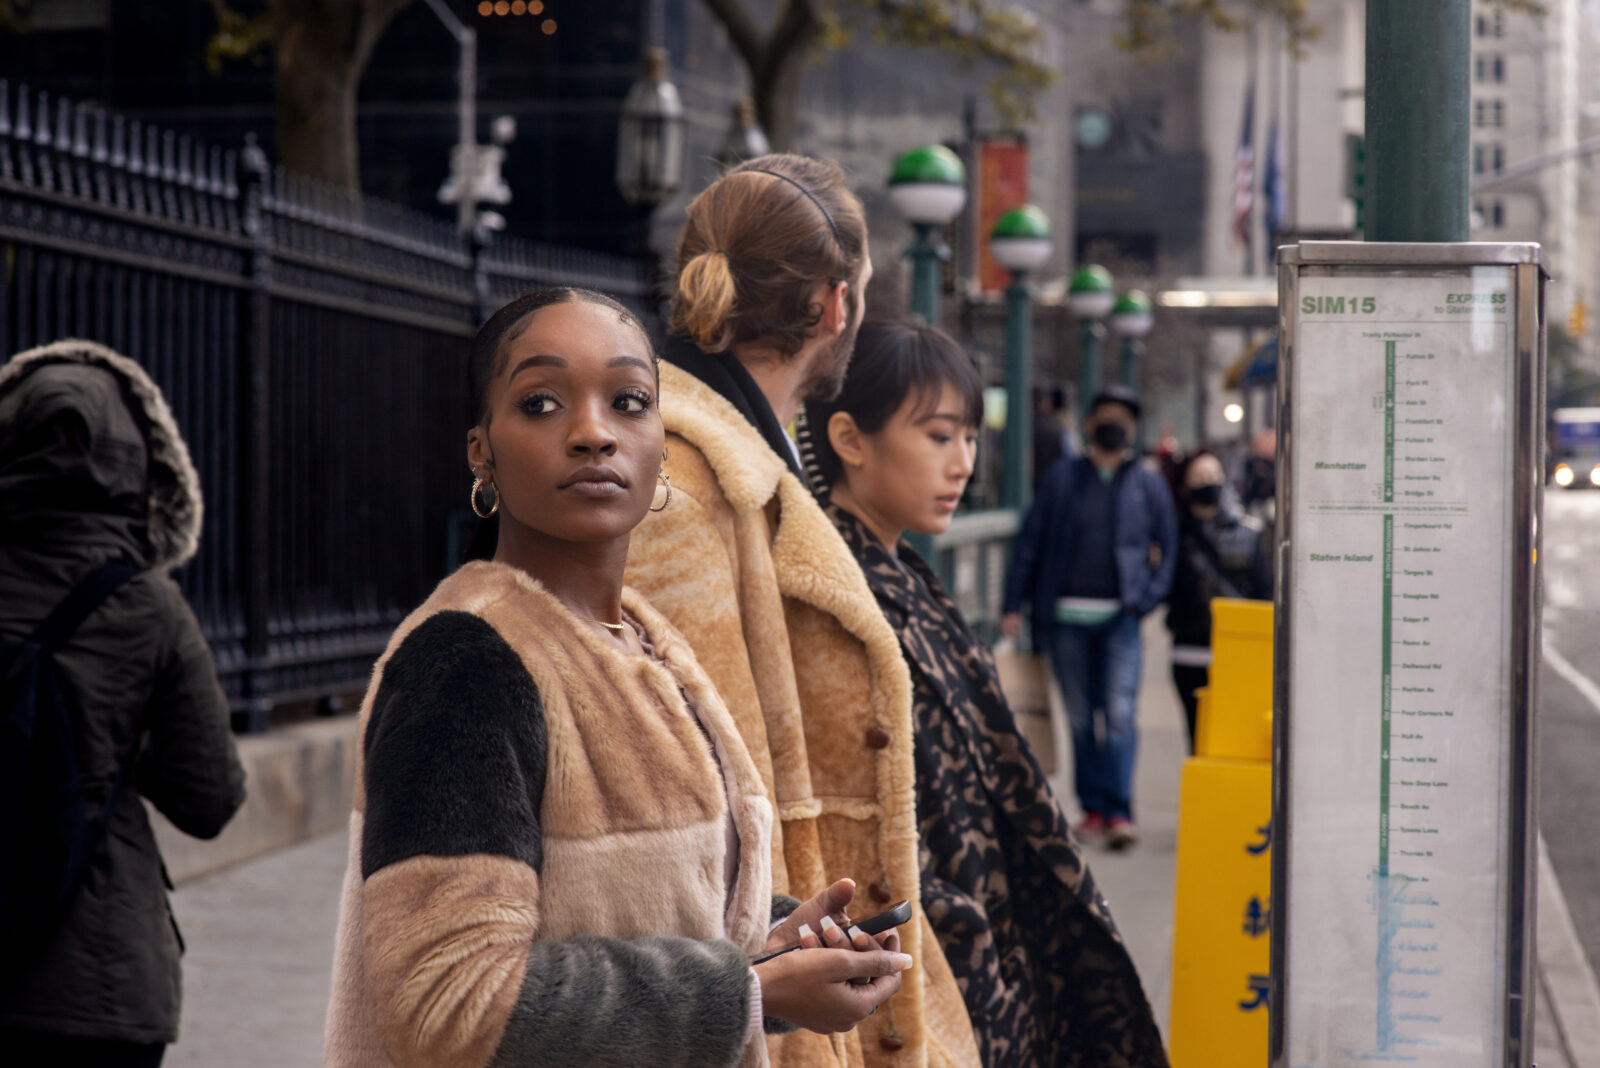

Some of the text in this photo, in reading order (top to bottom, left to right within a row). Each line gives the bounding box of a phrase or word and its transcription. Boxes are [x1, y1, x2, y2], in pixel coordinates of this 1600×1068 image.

[1446, 293, 1506, 304] EXPRESS
[1301, 296, 1376, 314] SIM15
[1434, 304, 1444, 314] to
[1314, 462, 1367, 470] Manhattan
[1309, 553, 1374, 562] Staten Island
